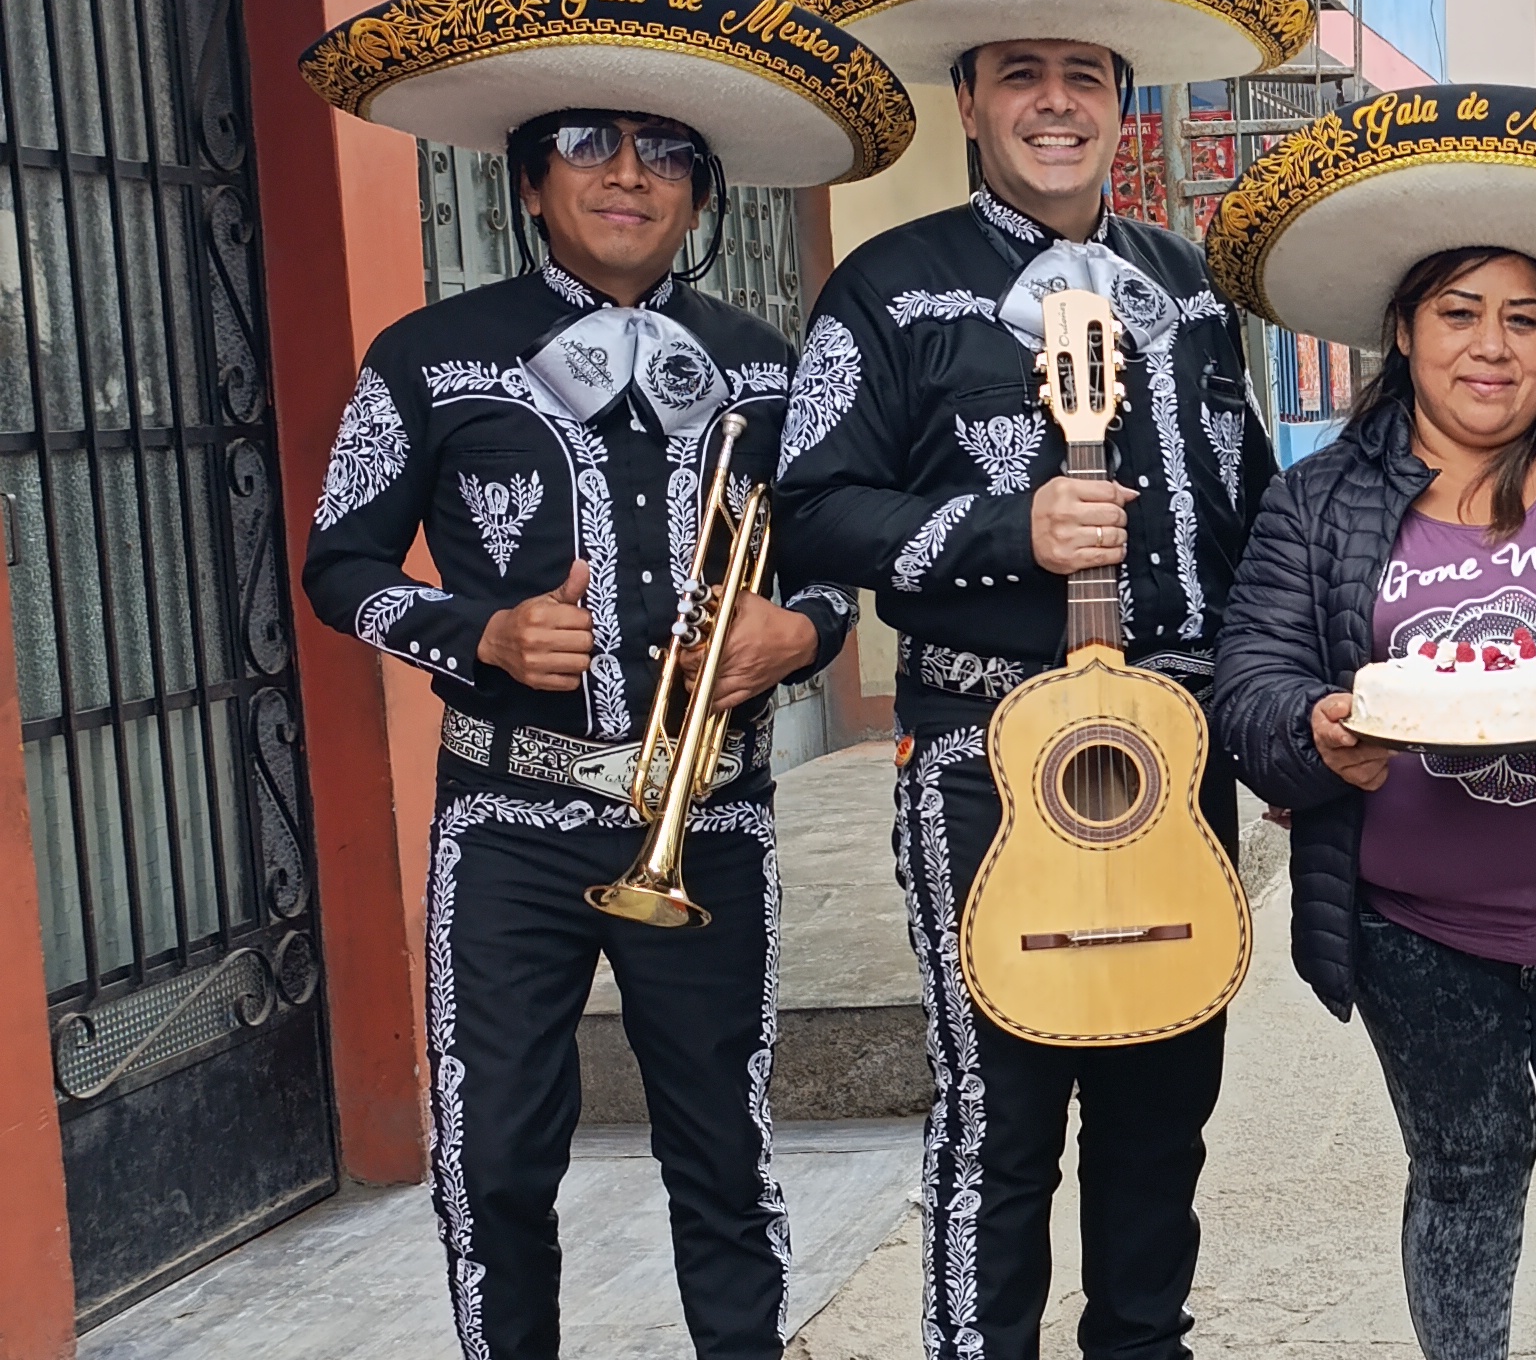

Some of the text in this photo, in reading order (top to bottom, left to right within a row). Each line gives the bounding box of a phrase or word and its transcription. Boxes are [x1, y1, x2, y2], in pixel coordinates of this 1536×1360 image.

[1352, 92, 1439, 147] Gala
[1456, 91, 1489, 120] de
[1378, 557, 1483, 603] Gone
